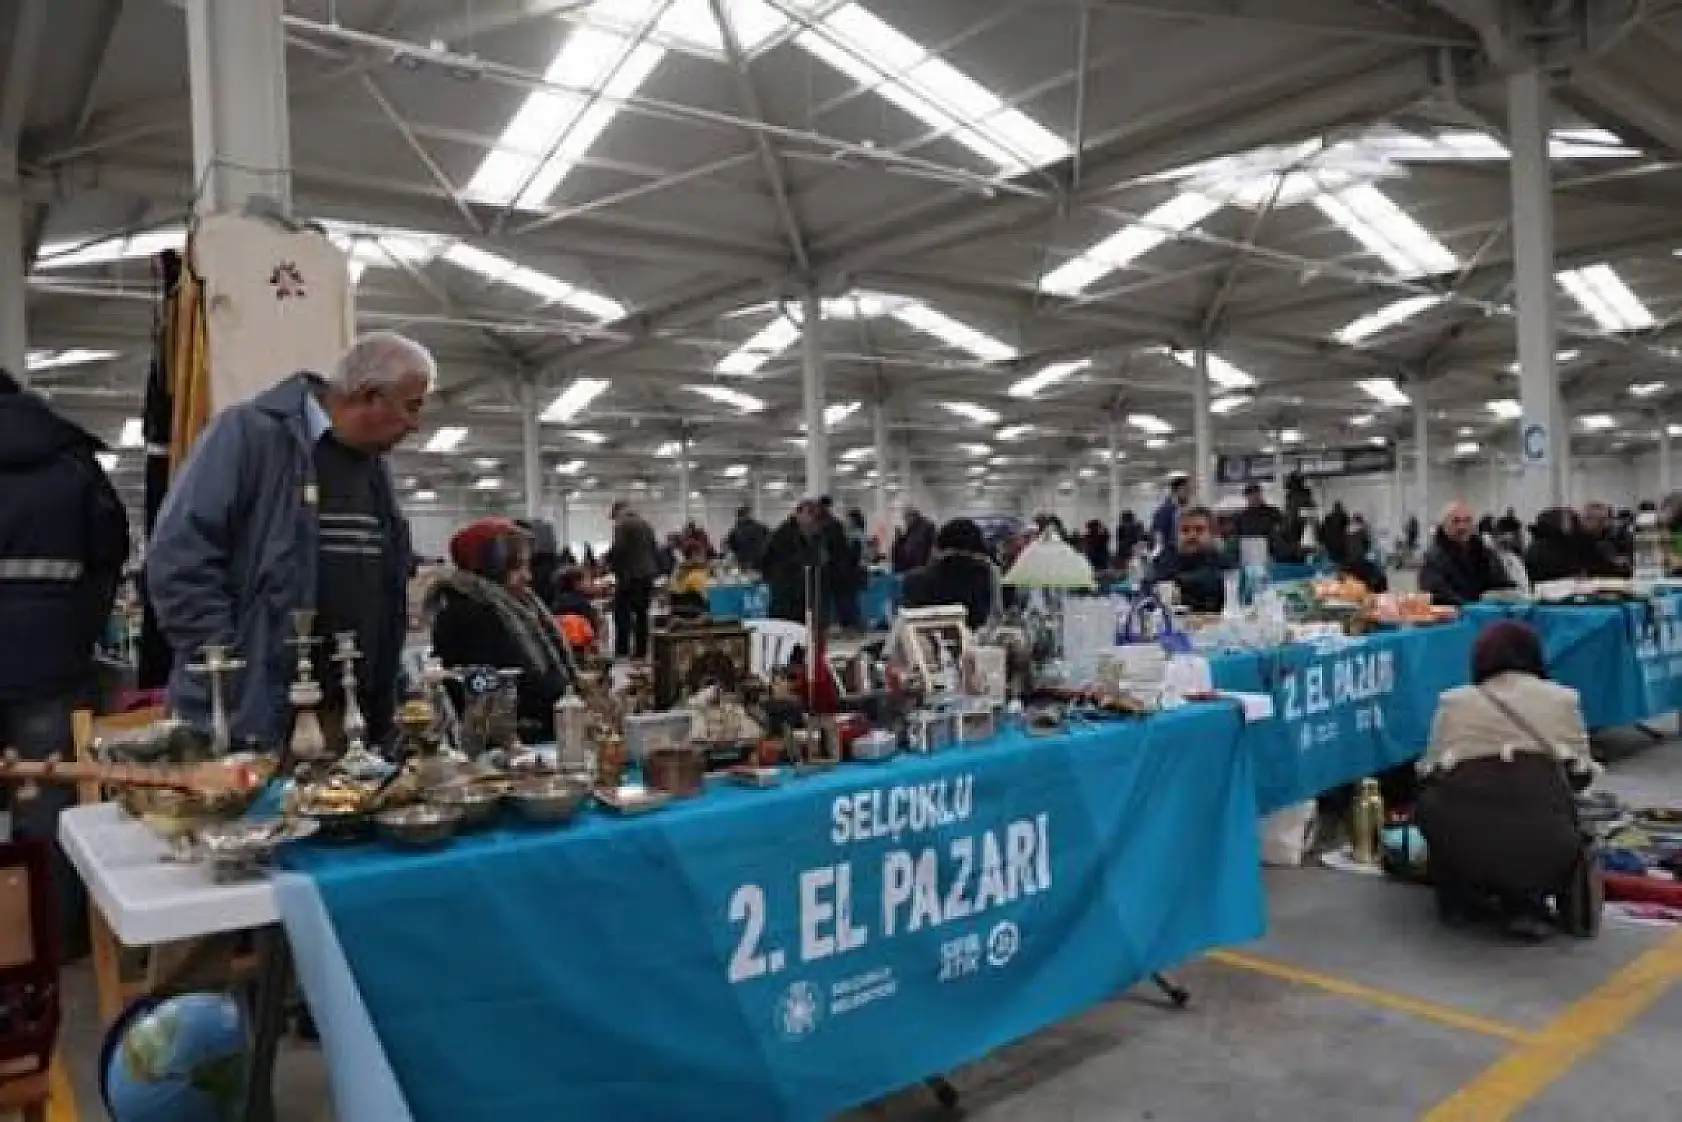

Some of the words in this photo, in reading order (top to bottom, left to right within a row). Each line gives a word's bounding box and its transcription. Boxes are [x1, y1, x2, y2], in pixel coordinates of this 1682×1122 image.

[1524, 424, 1545, 460] C
[832, 774, 973, 843] SELÇUKLU
[728, 884, 786, 983] 2.
[800, 862, 868, 961] EL
[882, 812, 1052, 936] PAZARI
